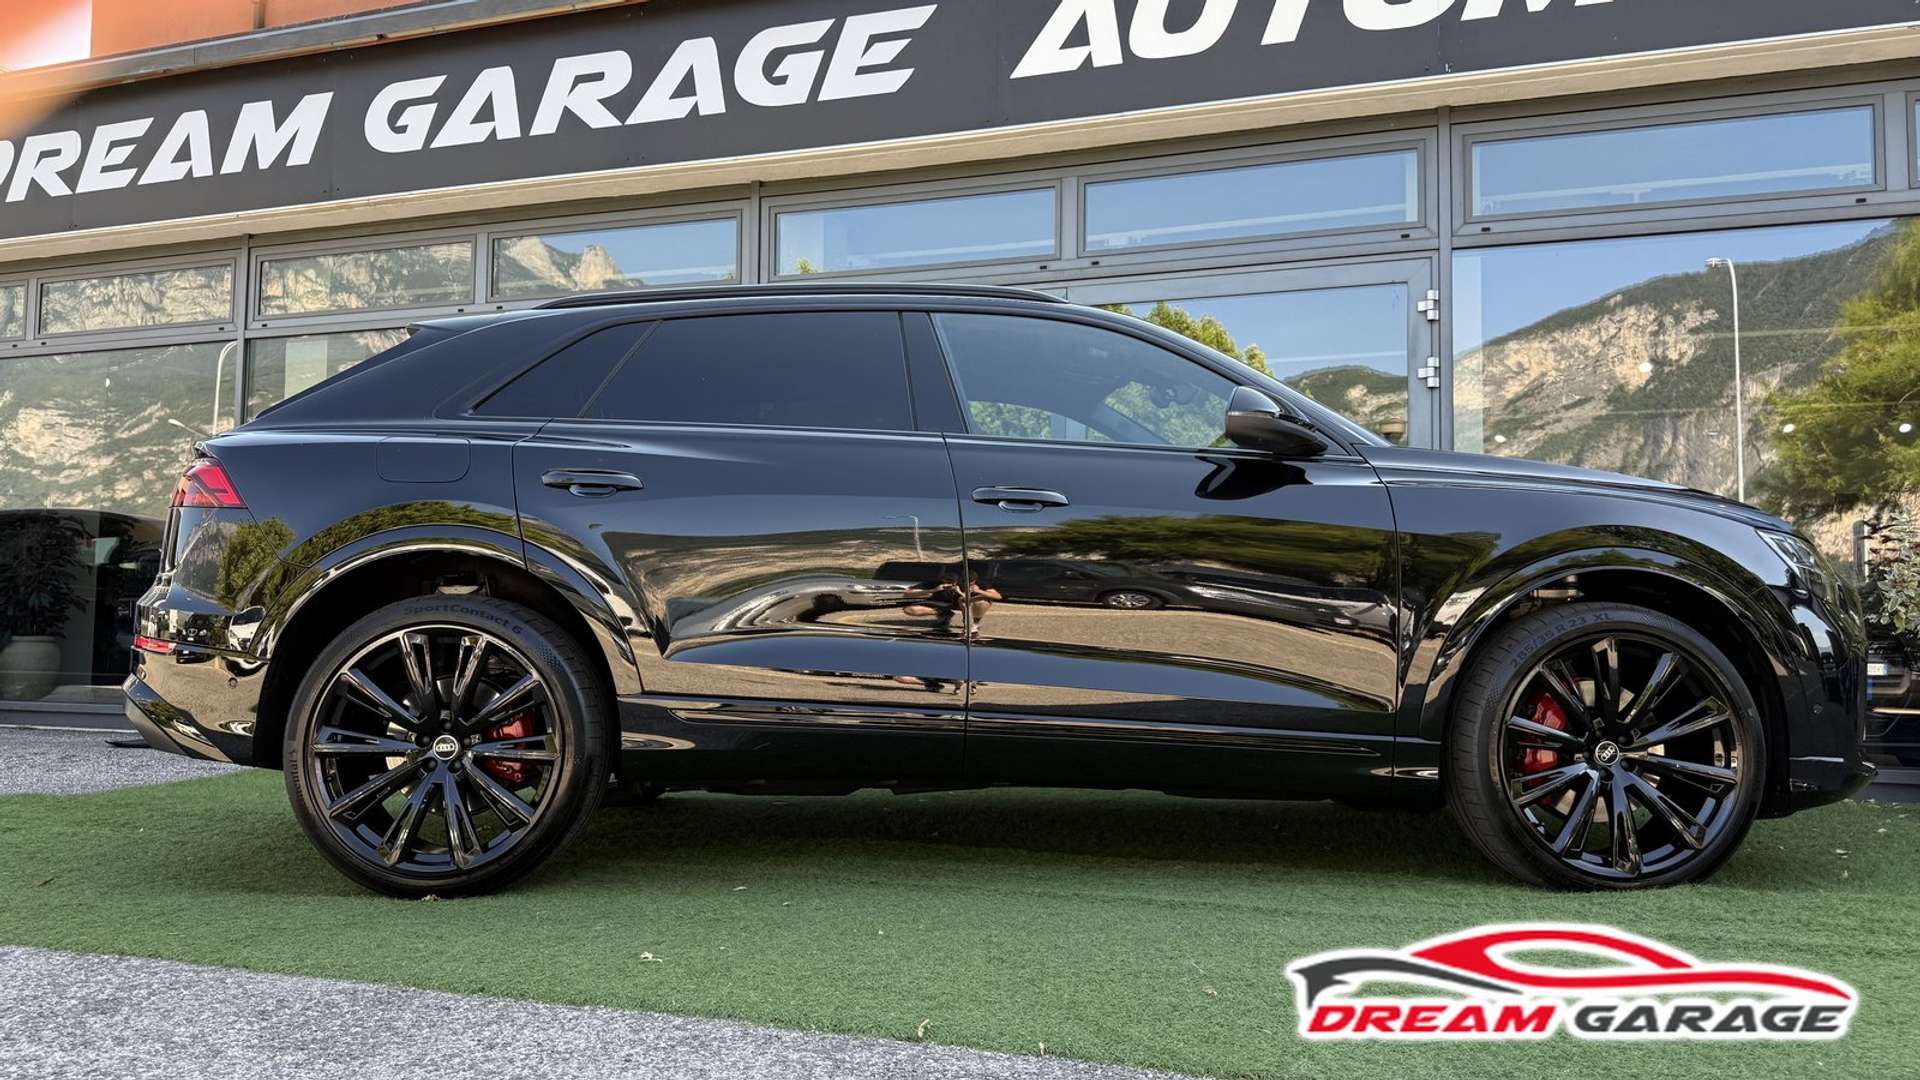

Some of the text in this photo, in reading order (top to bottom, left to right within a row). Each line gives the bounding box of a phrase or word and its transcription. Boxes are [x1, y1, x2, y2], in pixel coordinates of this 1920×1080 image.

[0, 92, 334, 203] REAM
[365, 4, 938, 153] GARAGE
[403, 603, 510, 627] SportContact
[1592, 611, 1615, 621] XL
